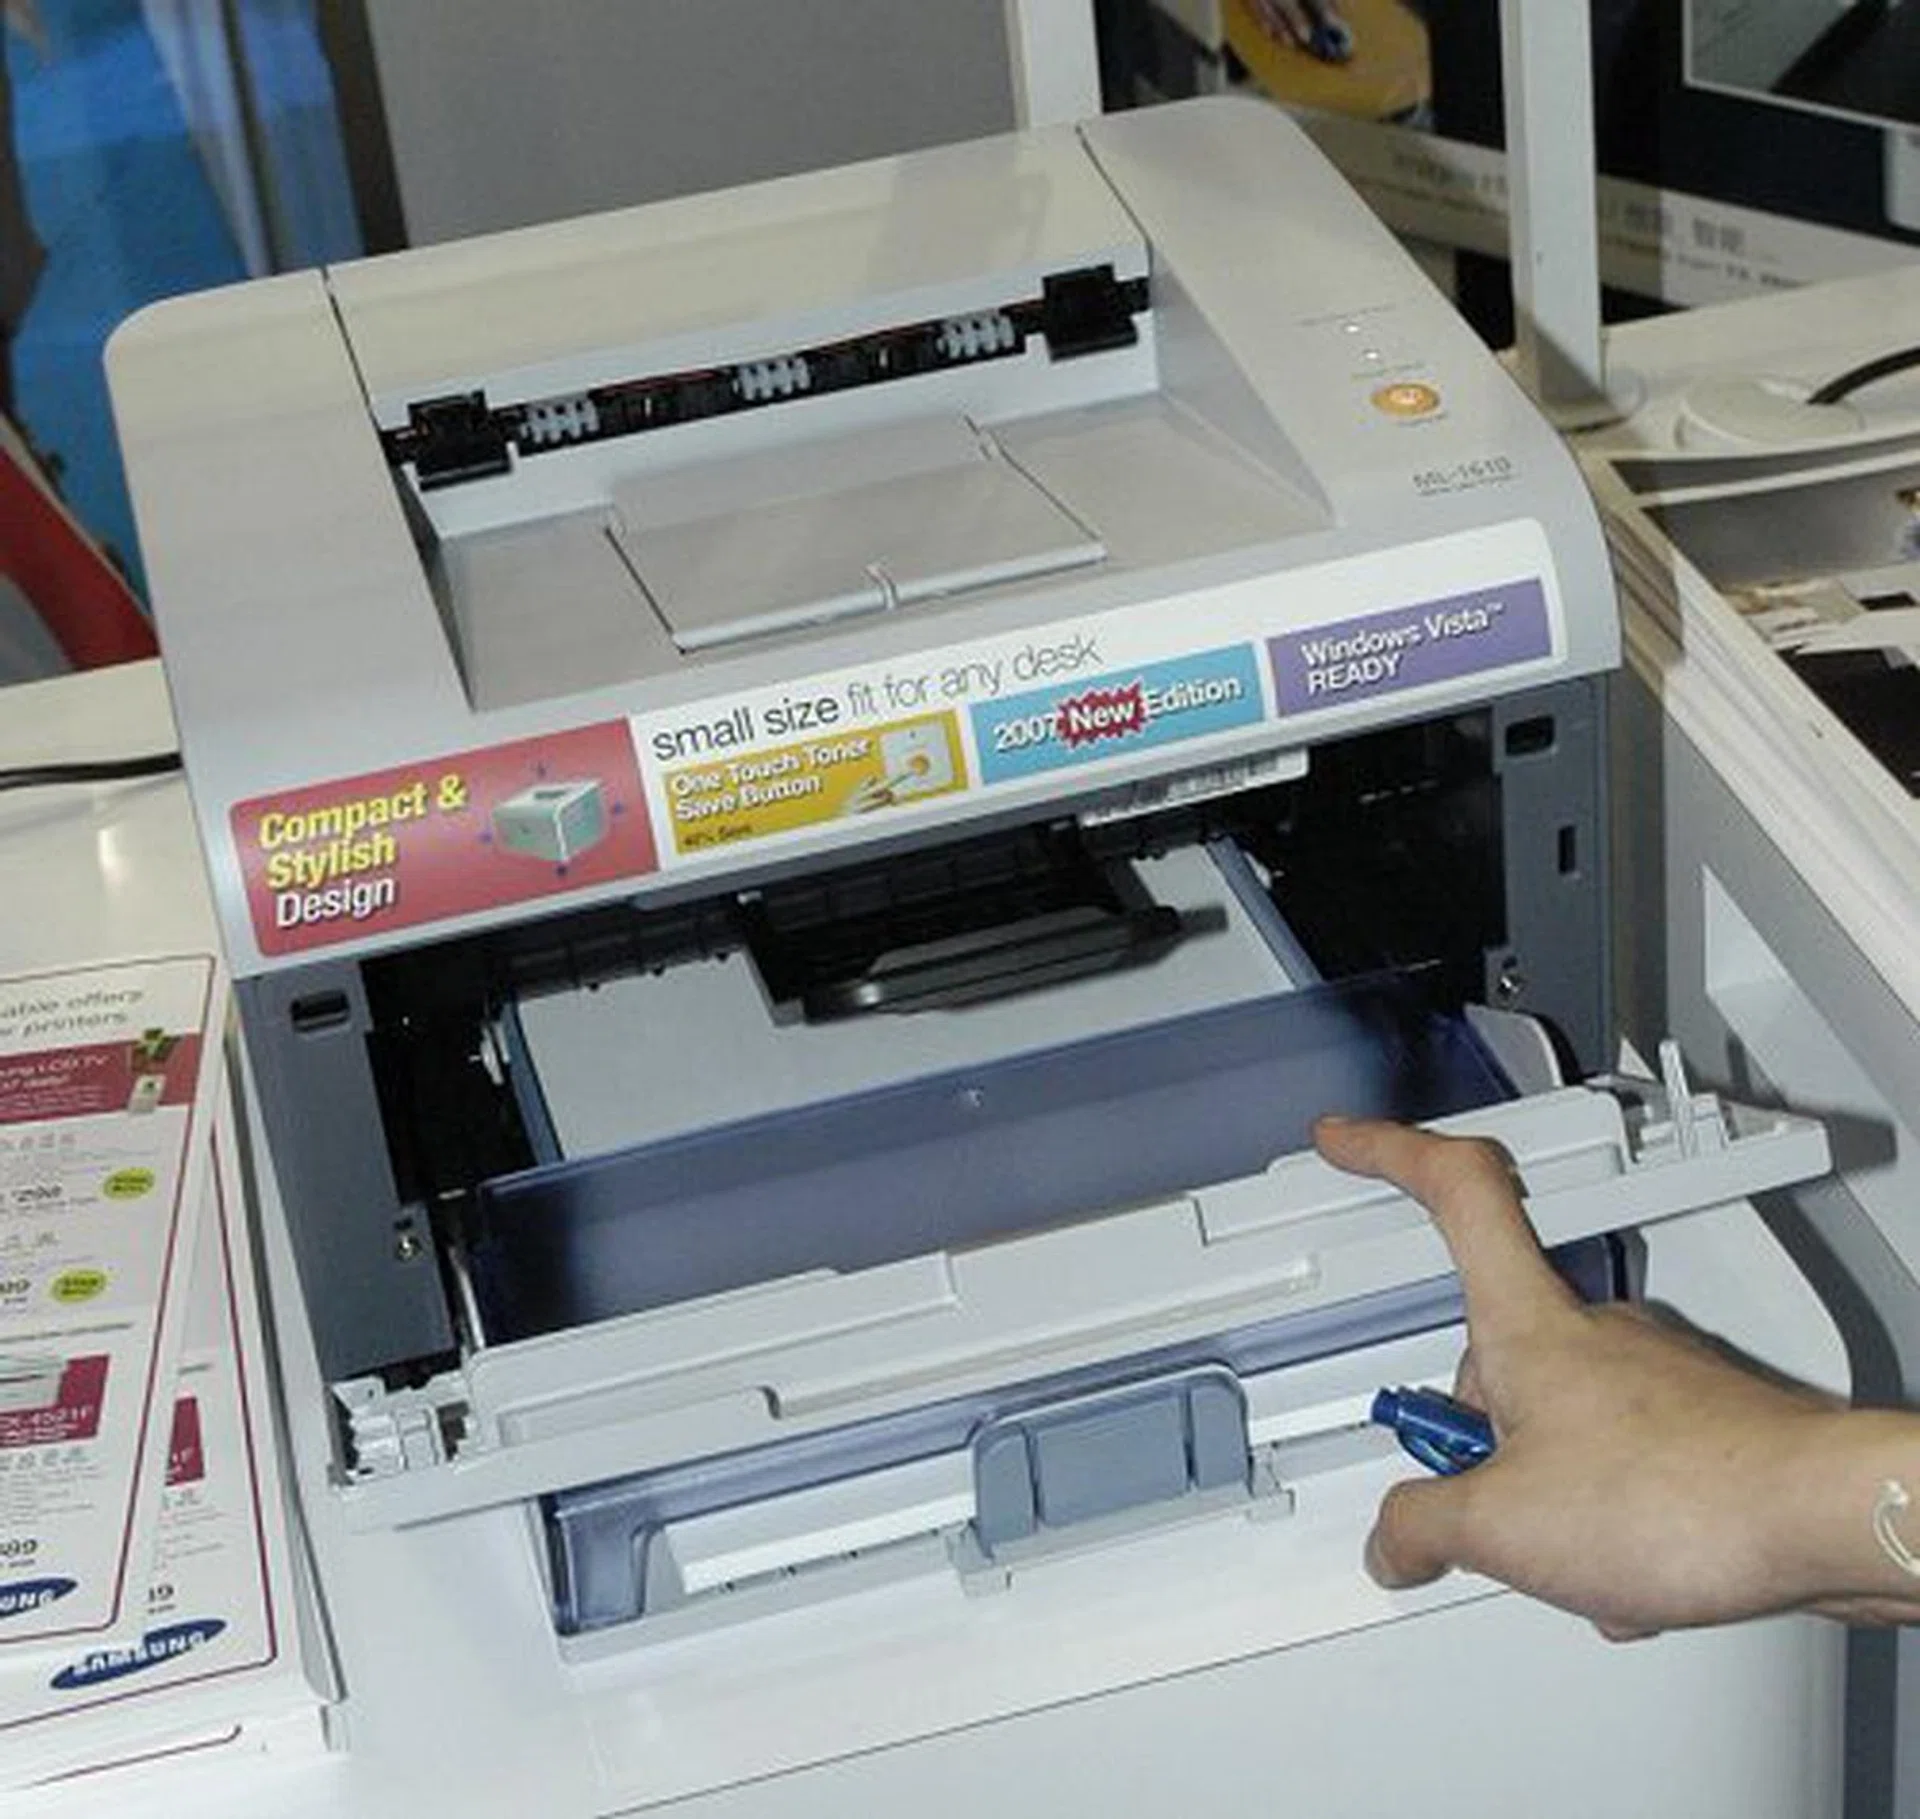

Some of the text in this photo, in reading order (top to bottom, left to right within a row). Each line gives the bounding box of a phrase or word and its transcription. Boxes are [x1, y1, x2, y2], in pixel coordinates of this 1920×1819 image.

[1300, 624, 1422, 669] Windows
[652, 633, 1106, 761] small size fit for any desk
[1306, 653, 1402, 696] READY
[993, 672, 1243, 753] 2007 New Edition
[671, 738, 872, 799] One Touch Toner
[258, 773, 469, 850] Compact &
[674, 774, 823, 822] Save Button
[267, 831, 397, 891] Stylish
[276, 875, 396, 930] Design
[22, 1012, 128, 1038] printers
[72, 1630, 206, 1679] SAMSUNG
